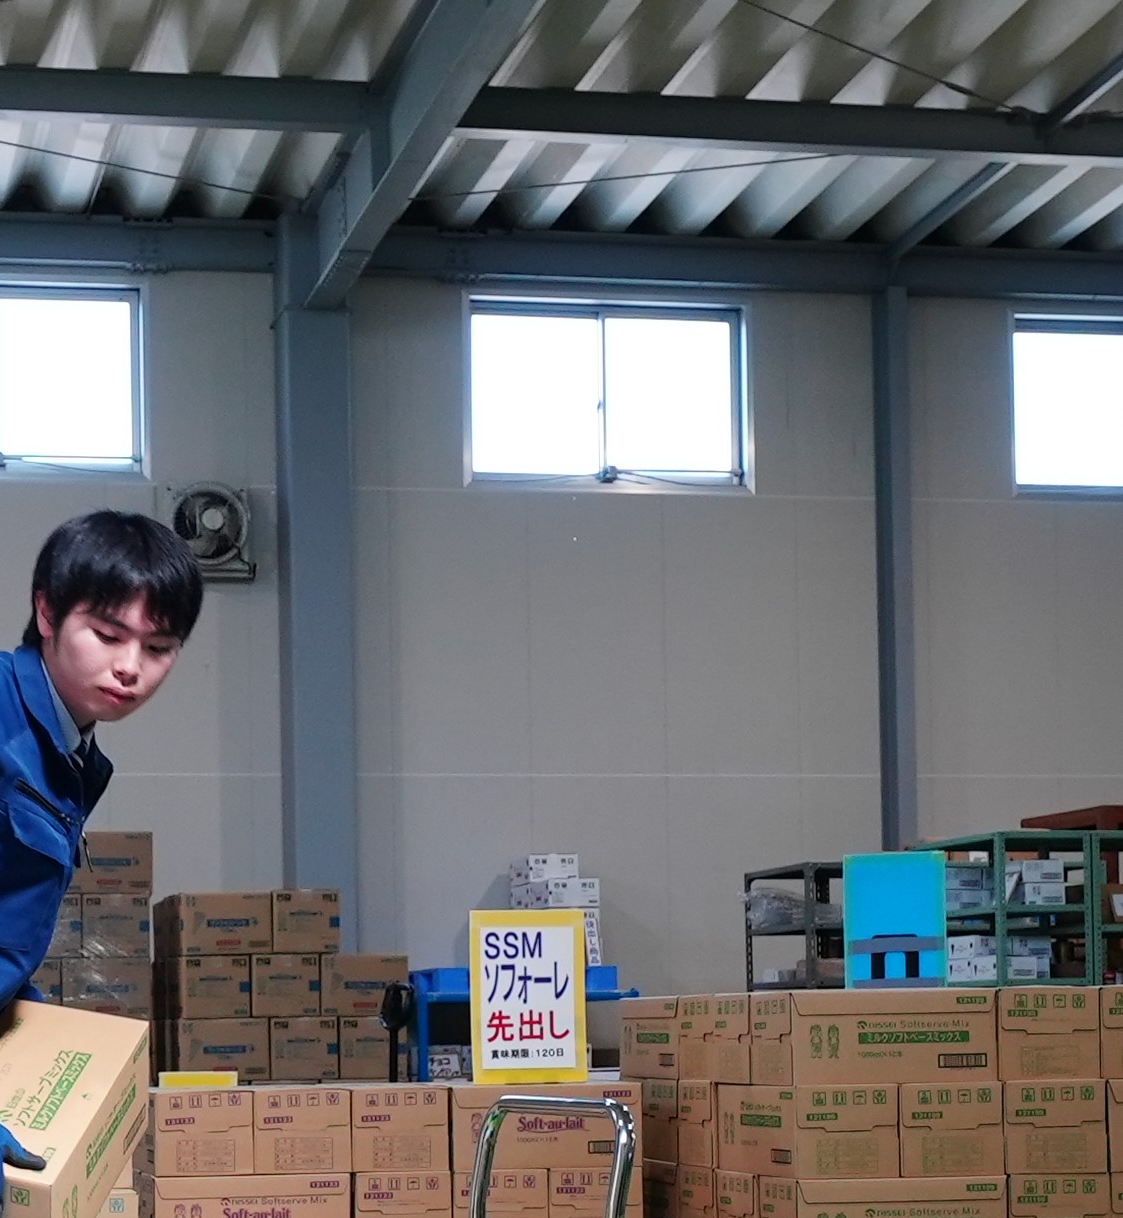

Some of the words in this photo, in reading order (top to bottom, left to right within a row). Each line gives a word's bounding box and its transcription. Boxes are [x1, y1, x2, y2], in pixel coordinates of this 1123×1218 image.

[484, 931, 542, 960] SSM
[484, 961, 569, 1004] ソフォーレ
[487, 1009, 570, 1042] 先出し
